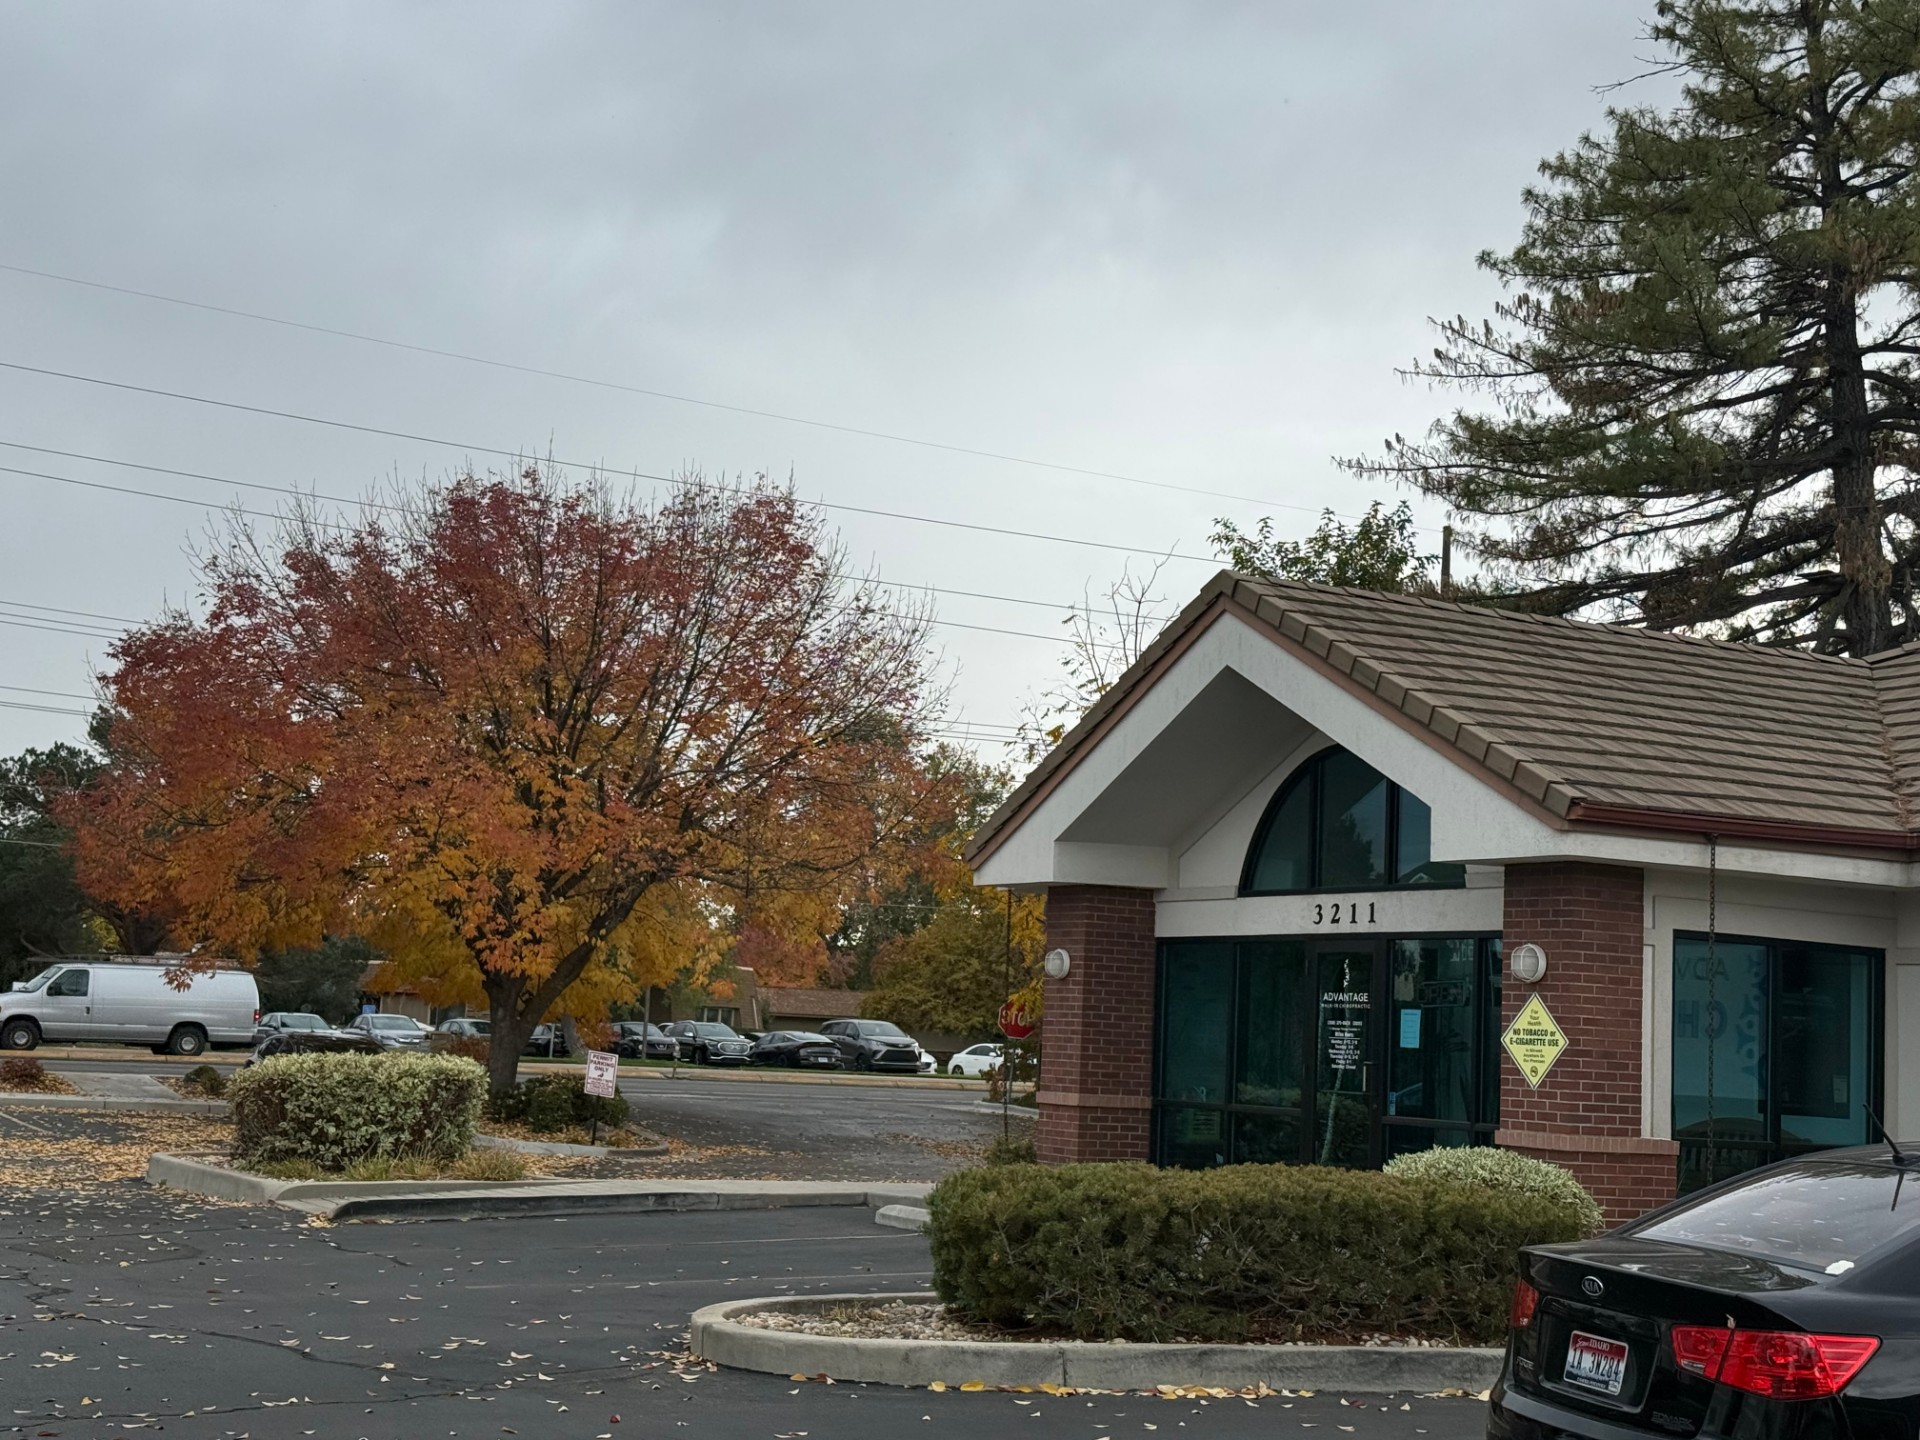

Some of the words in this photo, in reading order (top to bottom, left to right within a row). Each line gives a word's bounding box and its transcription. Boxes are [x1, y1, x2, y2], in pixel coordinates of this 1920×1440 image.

[1312, 902, 1377, 925] 3211
[1323, 992, 1369, 1002] ADVANTAGE
[1512, 1028, 1521, 1037] NO
[1522, 1028, 1549, 1038] TOBACCO
[1549, 1030, 1557, 1038] or
[1509, 1037, 1547, 1047] E-CIGARETTE
[1547, 1038, 1560, 1048] USE
[1589, 1339, 1610, 1352] IDAHO
[1570, 1348, 1584, 1370] 1A
